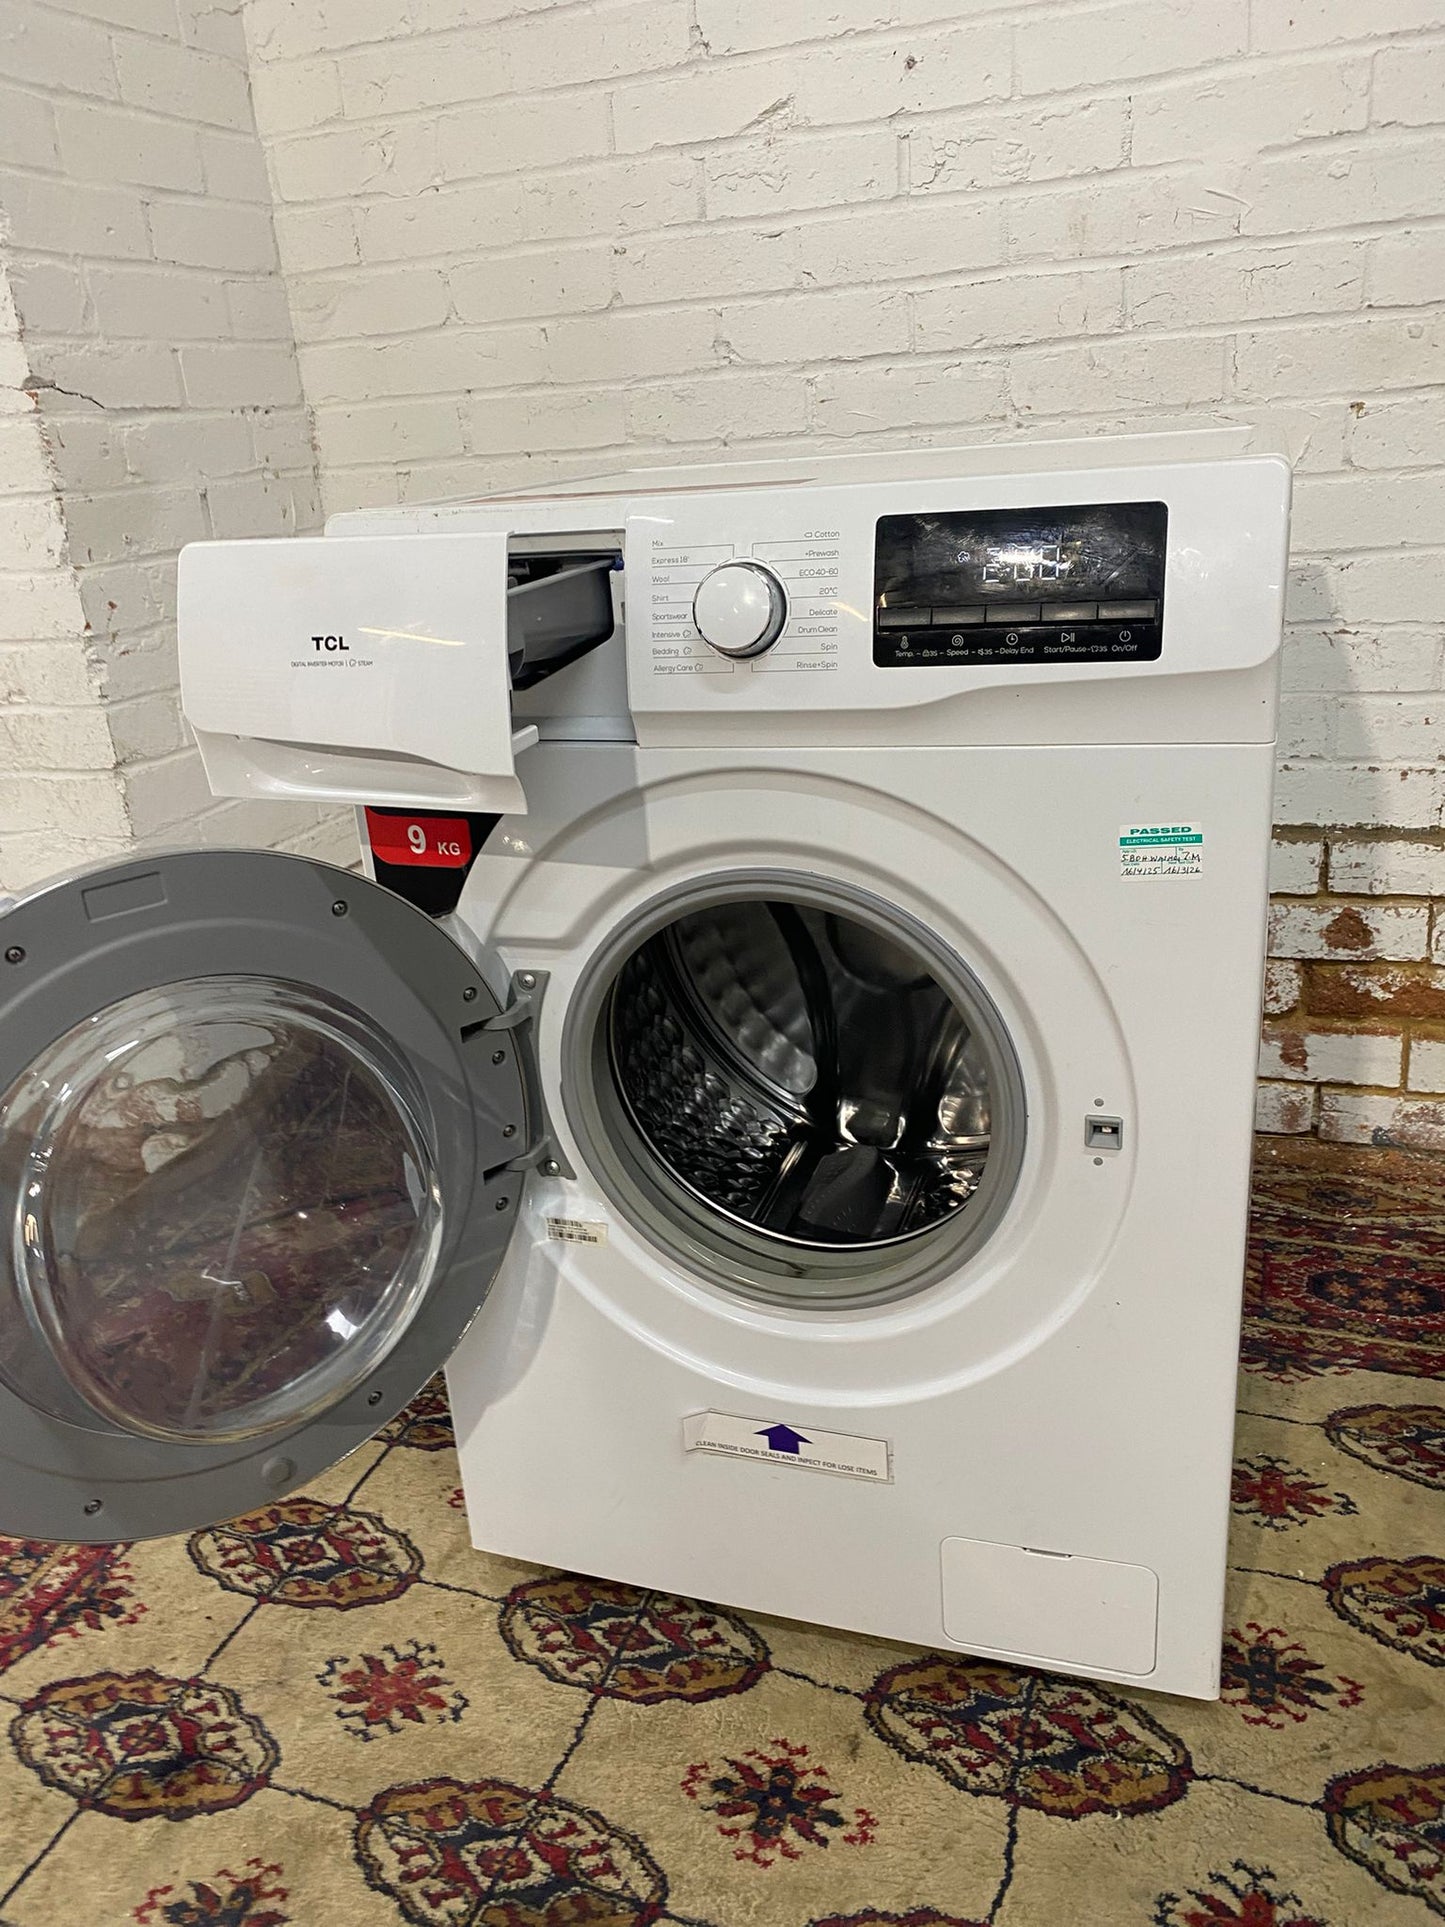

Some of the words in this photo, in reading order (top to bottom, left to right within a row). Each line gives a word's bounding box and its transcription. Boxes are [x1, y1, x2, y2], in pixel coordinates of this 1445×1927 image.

[814, 530, 840, 538] Cotton
[651, 540, 664, 548] Mix
[651, 557, 679, 565] Express
[799, 568, 815, 577] ECO
[651, 575, 670, 583] Wool
[819, 587, 839, 595] 20°C
[651, 594, 670, 602] Shirt
[651, 612, 689, 621] Sportswear
[809, 608, 839, 616] Delicate
[798, 626, 817, 634] Drum
[817, 625, 838, 633] Clean
[651, 630, 681, 639] Intensive
[311, 635, 350, 651] TCL
[820, 642, 838, 651] Spin
[652, 647, 680, 656] Bedding
[946, 648, 969, 657] Speed
[1000, 646, 1020, 655] Delay
[1020, 646, 1035, 654] End
[1111, 644, 1139, 652] On/Off
[653, 663, 676, 673] Allergy
[676, 663, 694, 672] Care
[1130, 826, 1192, 835] PASSED
[407, 824, 427, 855] 9
[437, 841, 461, 856] KG
[1126, 837, 1159, 845] ELECTRICAL
[695, 1440, 717, 1448] CLEAN
[717, 1443, 739, 1452] INSIDE
[740, 1446, 760, 1455] DOOR
[760, 1450, 780, 1459] SEALS
[781, 1454, 797, 1462] AND
[797, 1457, 821, 1467] INPECT
[822, 1461, 837, 1470] FOR
[837, 1464, 855, 1473] LOSE
[855, 1467, 878, 1476] ITEMS
